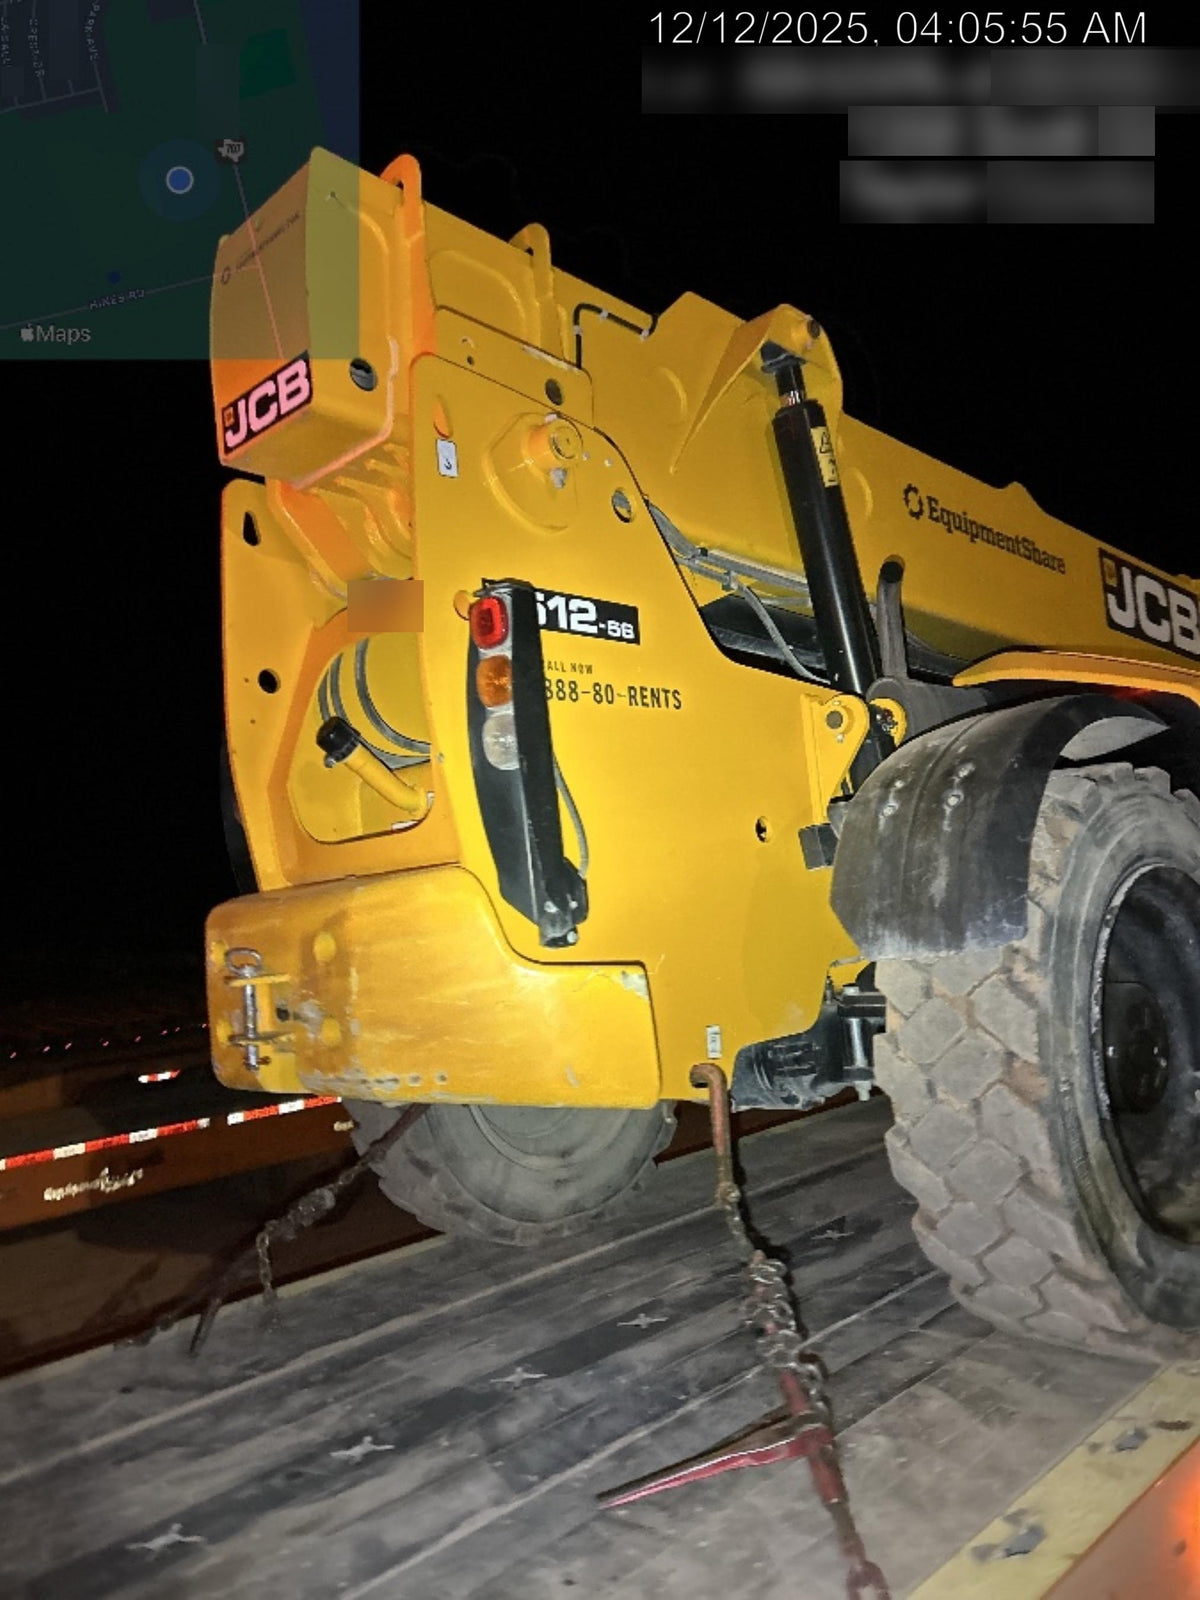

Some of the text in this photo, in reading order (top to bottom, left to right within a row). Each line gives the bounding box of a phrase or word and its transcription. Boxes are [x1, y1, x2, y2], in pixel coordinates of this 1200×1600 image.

[224, 358, 310, 448] JCB
[926, 496, 1066, 575] EquipmentShare
[1107, 566, 1200, 655] JCB
[545, 660, 593, 675] ALL NOW
